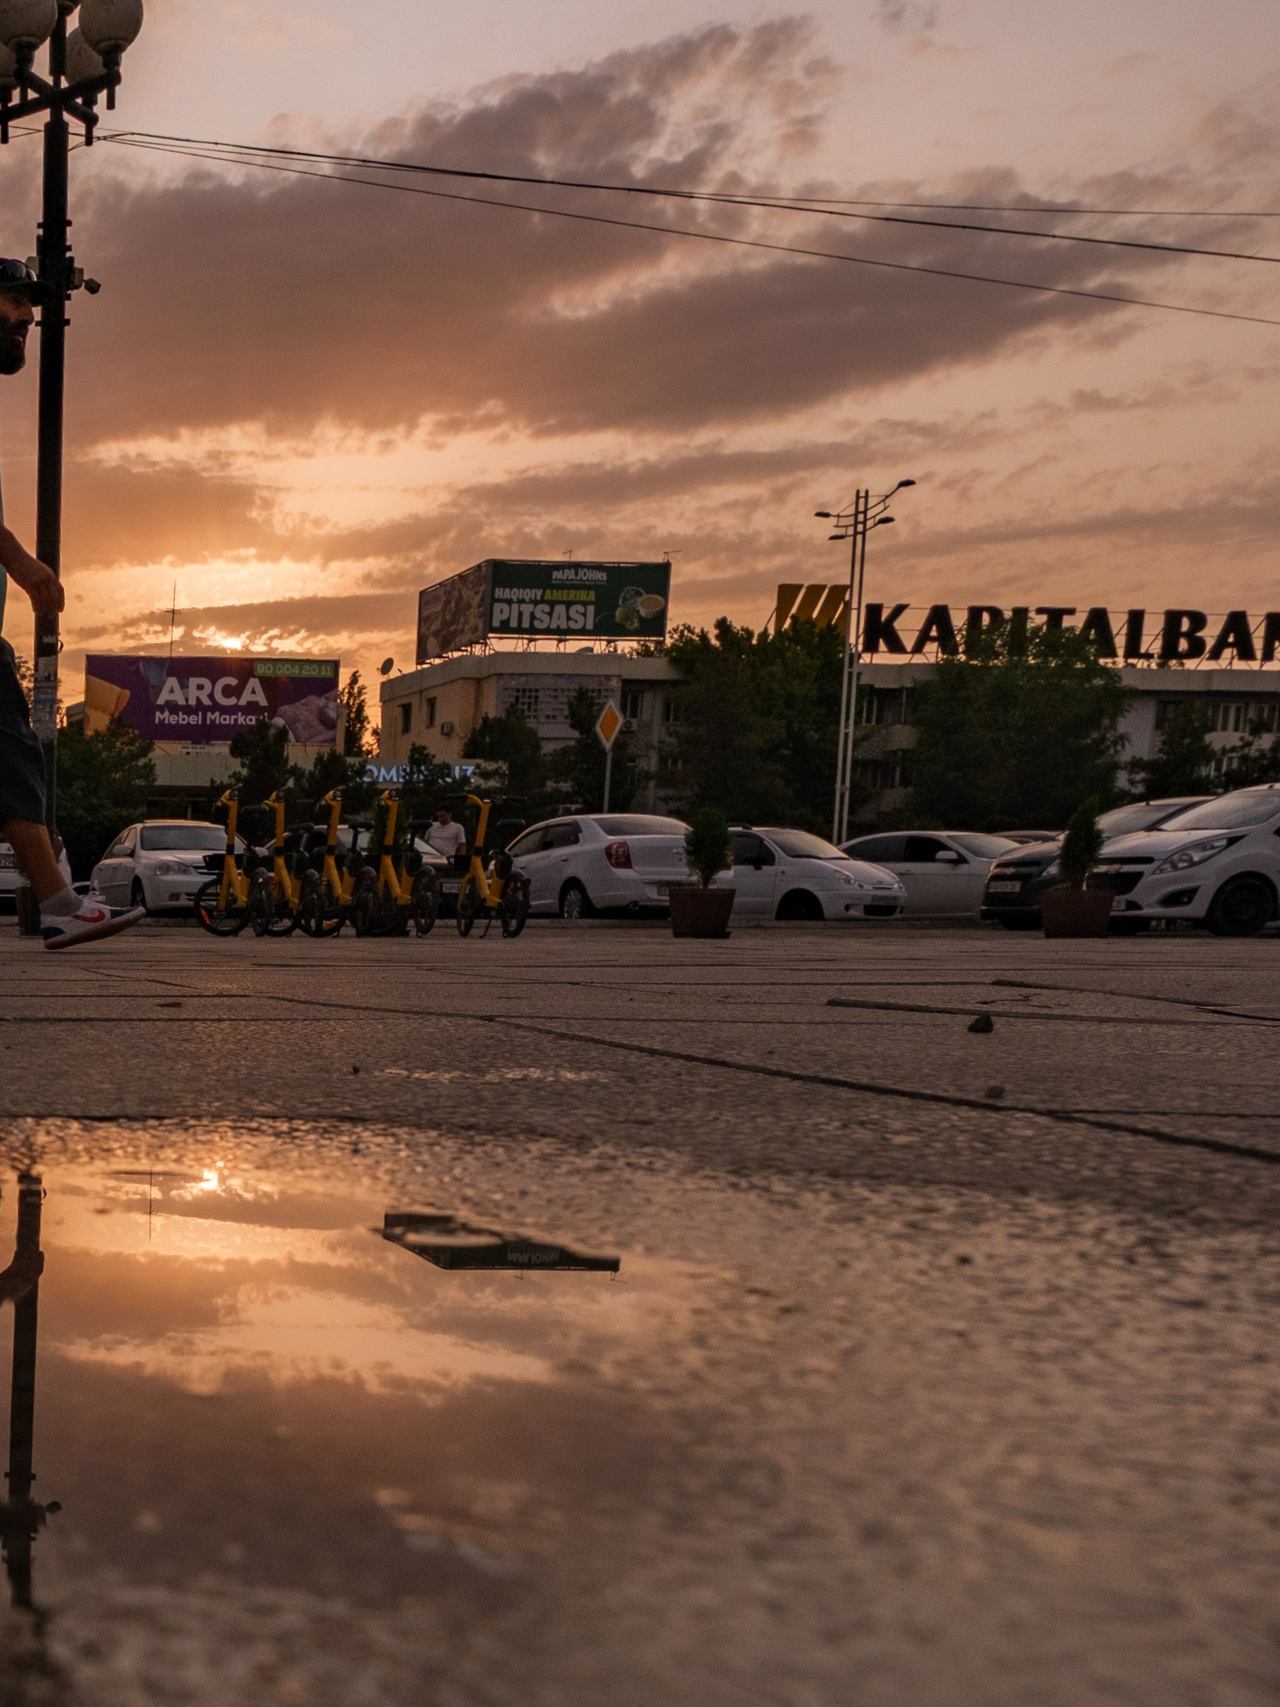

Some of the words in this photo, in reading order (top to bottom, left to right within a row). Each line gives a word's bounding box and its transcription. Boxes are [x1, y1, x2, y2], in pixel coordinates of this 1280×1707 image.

[494, 587, 543, 602] HAQIQIY
[544, 589, 596, 602] AMERIKA
[492, 602, 595, 630] PITSASI
[155, 676, 268, 707] ARCA
[155, 711, 202, 725] Mebel
